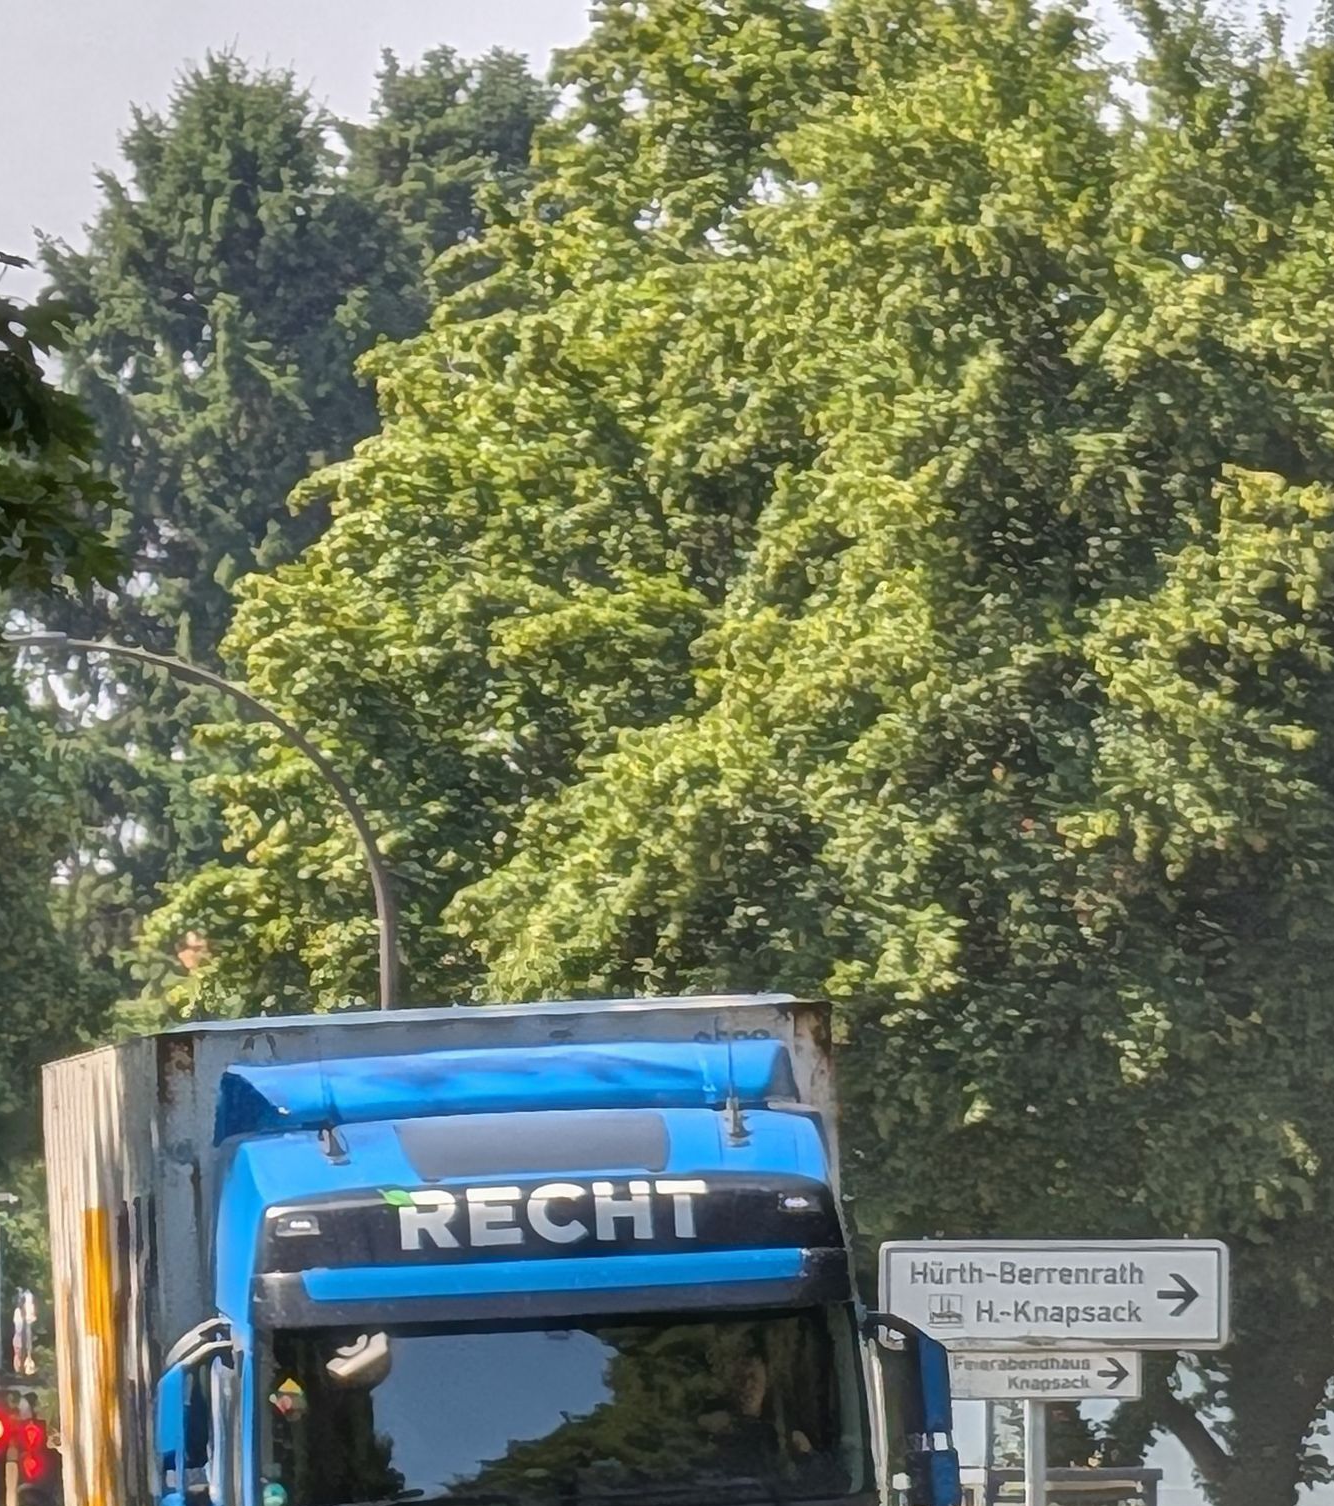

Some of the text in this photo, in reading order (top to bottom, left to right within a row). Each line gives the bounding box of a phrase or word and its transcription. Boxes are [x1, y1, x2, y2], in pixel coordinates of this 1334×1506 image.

[397, 1179, 709, 1251] RECHT
[910, 1261, 1144, 1286] Hürth-Berrenrath
[976, 1300, 1143, 1328] H.-Knapsack
[1008, 1375, 1092, 1392] Knapsack
